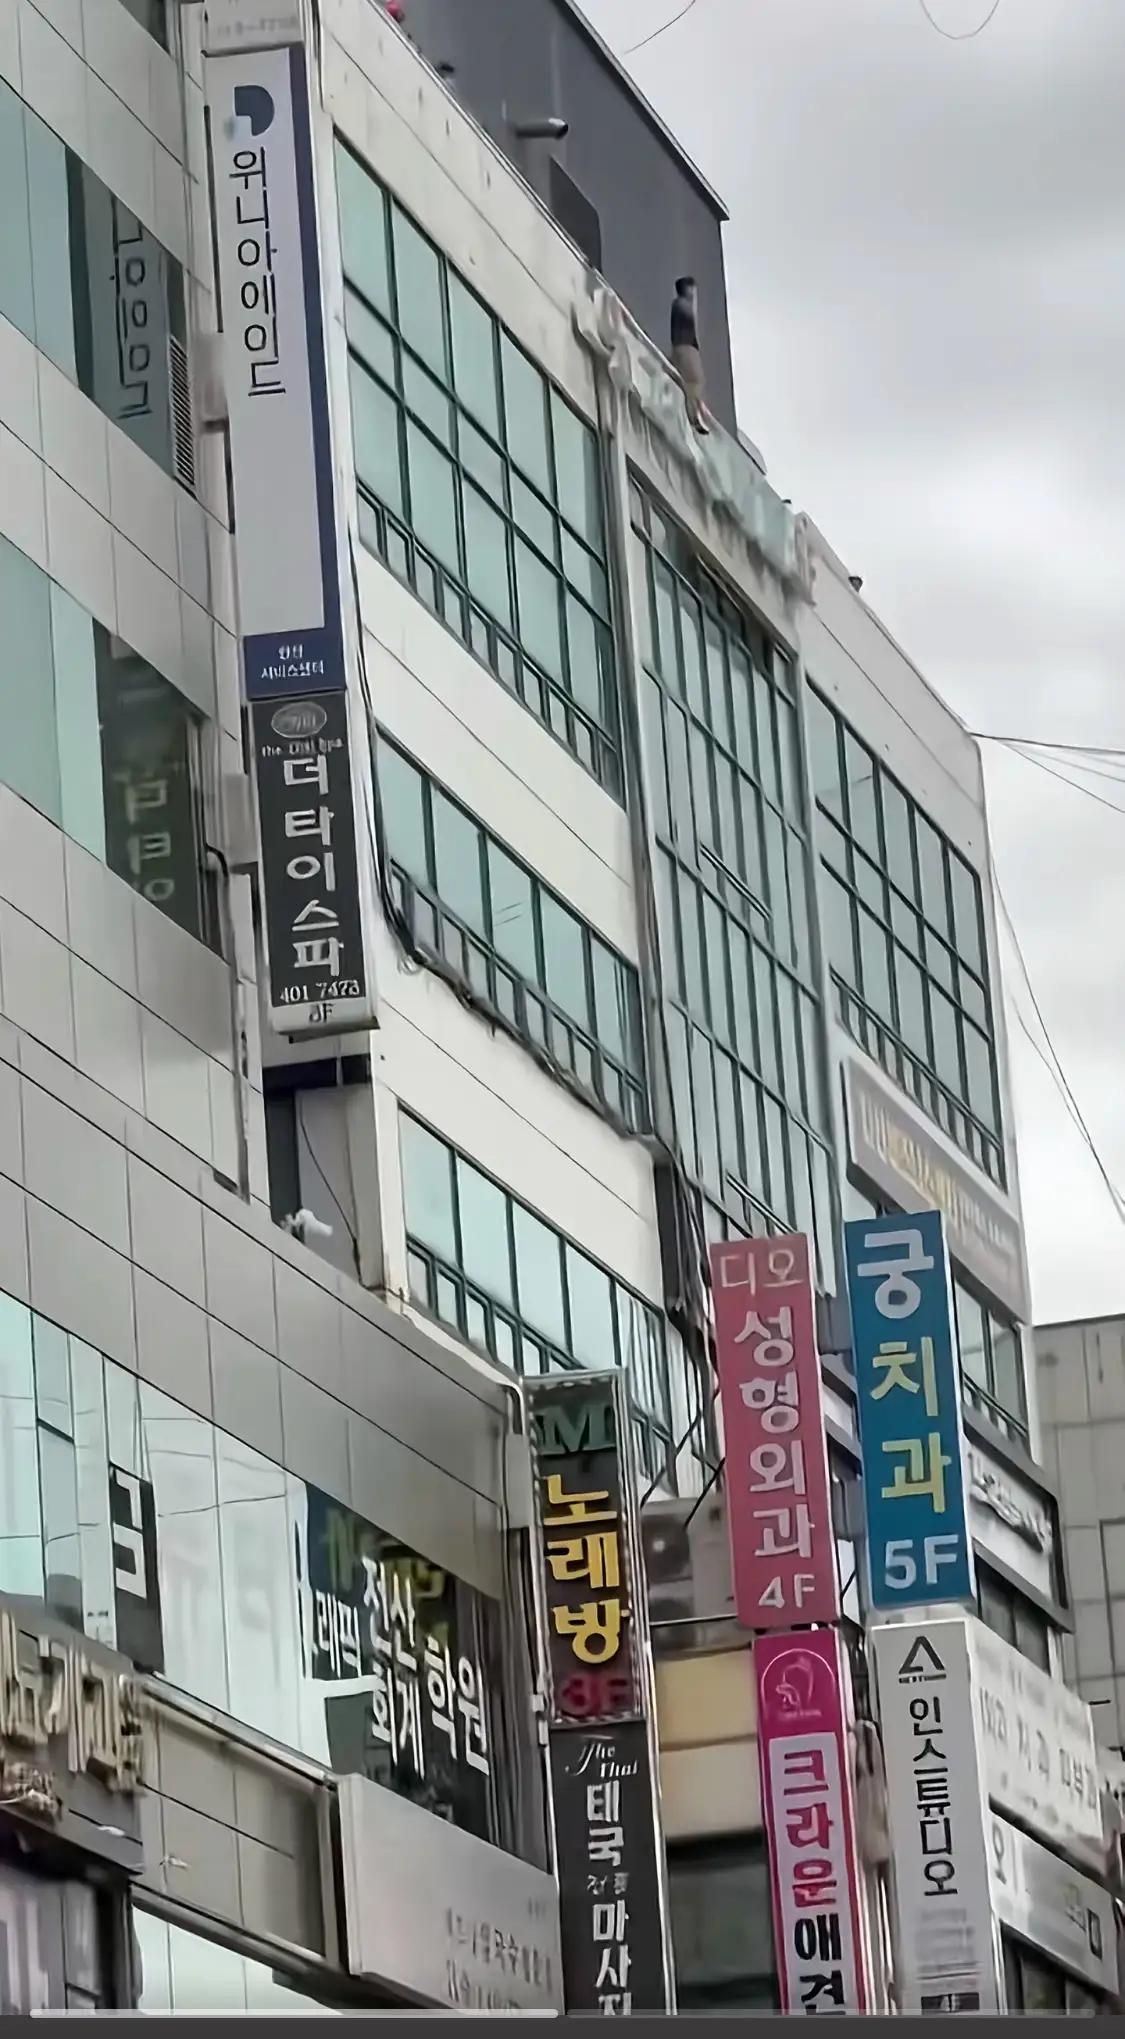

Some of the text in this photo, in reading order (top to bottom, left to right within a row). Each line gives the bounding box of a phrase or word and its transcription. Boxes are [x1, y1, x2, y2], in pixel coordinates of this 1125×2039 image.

[280, 985, 309, 1003] 401
[719, 1248, 804, 1296] 디오
[734, 1305, 815, 1559] 성형외과
[544, 1474, 630, 1664] 노래방
[758, 1573, 816, 1609] 4F
[883, 1534, 960, 1590] 5F
[423, 1634, 490, 1776] 학원
[586, 1780, 625, 1867] 태국
[909, 1695, 959, 1897] 인스튜디오
